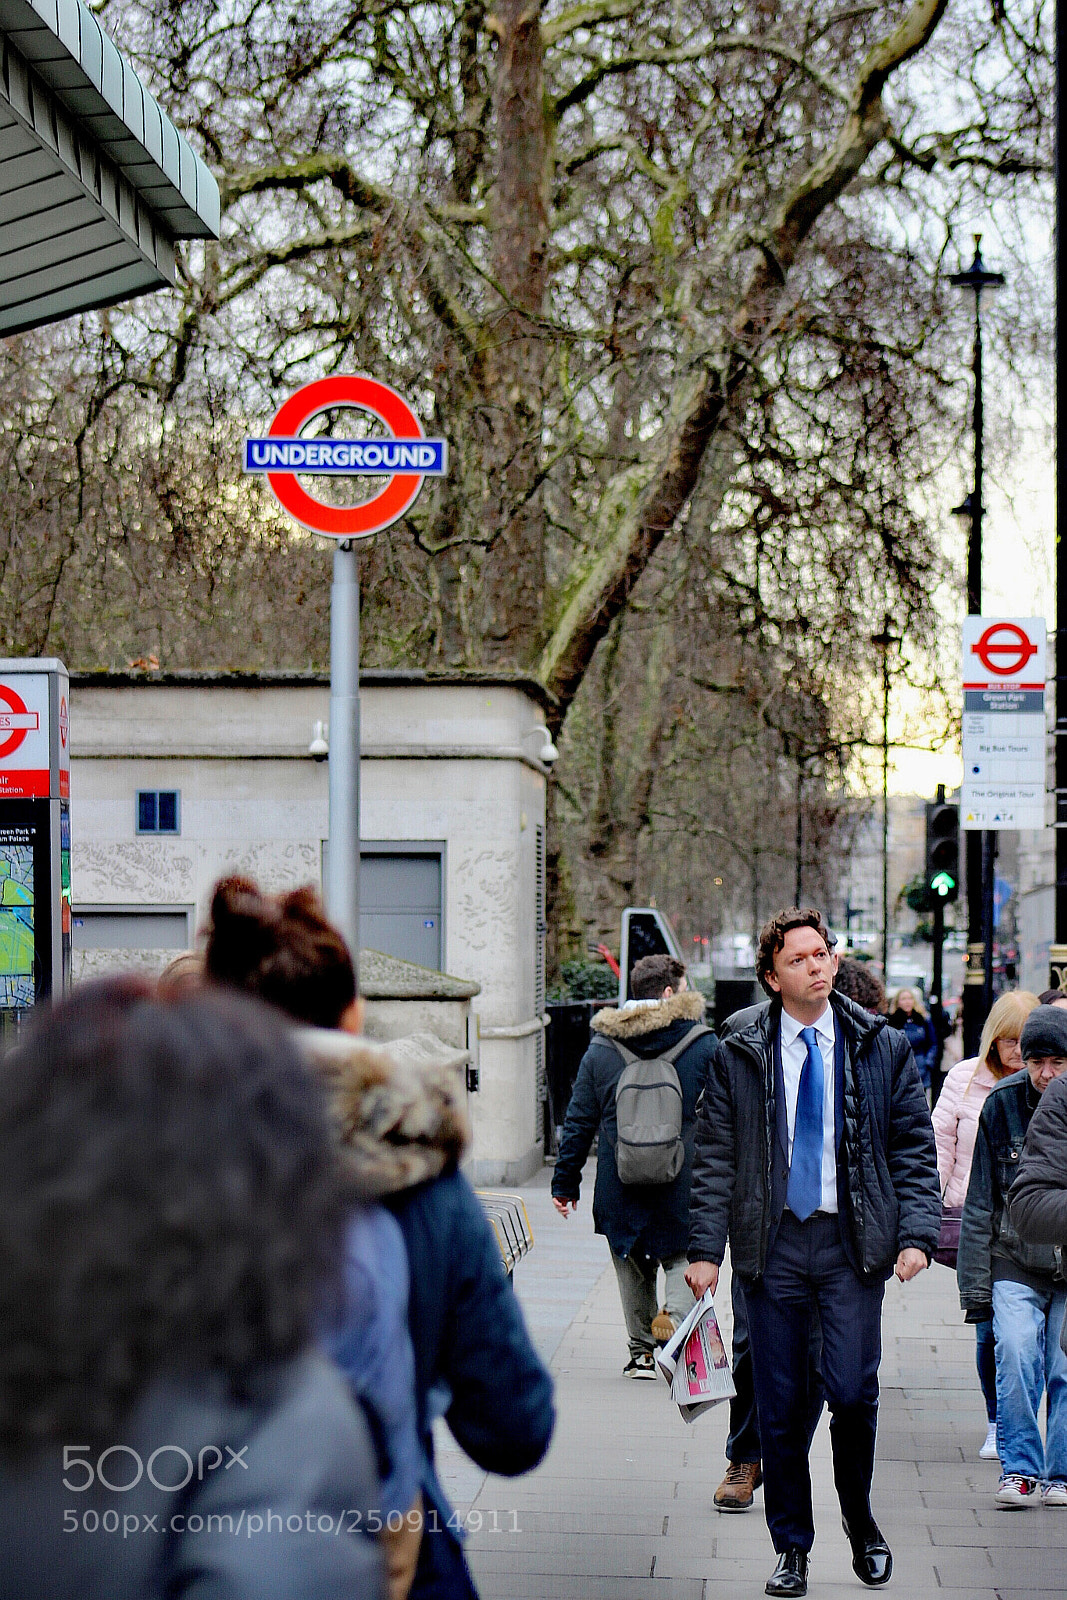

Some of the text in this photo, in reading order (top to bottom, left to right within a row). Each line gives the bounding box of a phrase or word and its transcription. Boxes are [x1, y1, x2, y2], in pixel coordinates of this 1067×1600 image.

[252, 442, 437, 468] UNDERGROUND
[983, 692, 1026, 702] Green Park
[990, 701, 1020, 710] Station
[979, 745, 1029, 753] Big Bus Tours
[987, 790, 1016, 799] Original
[15, 827, 30, 835] Park
